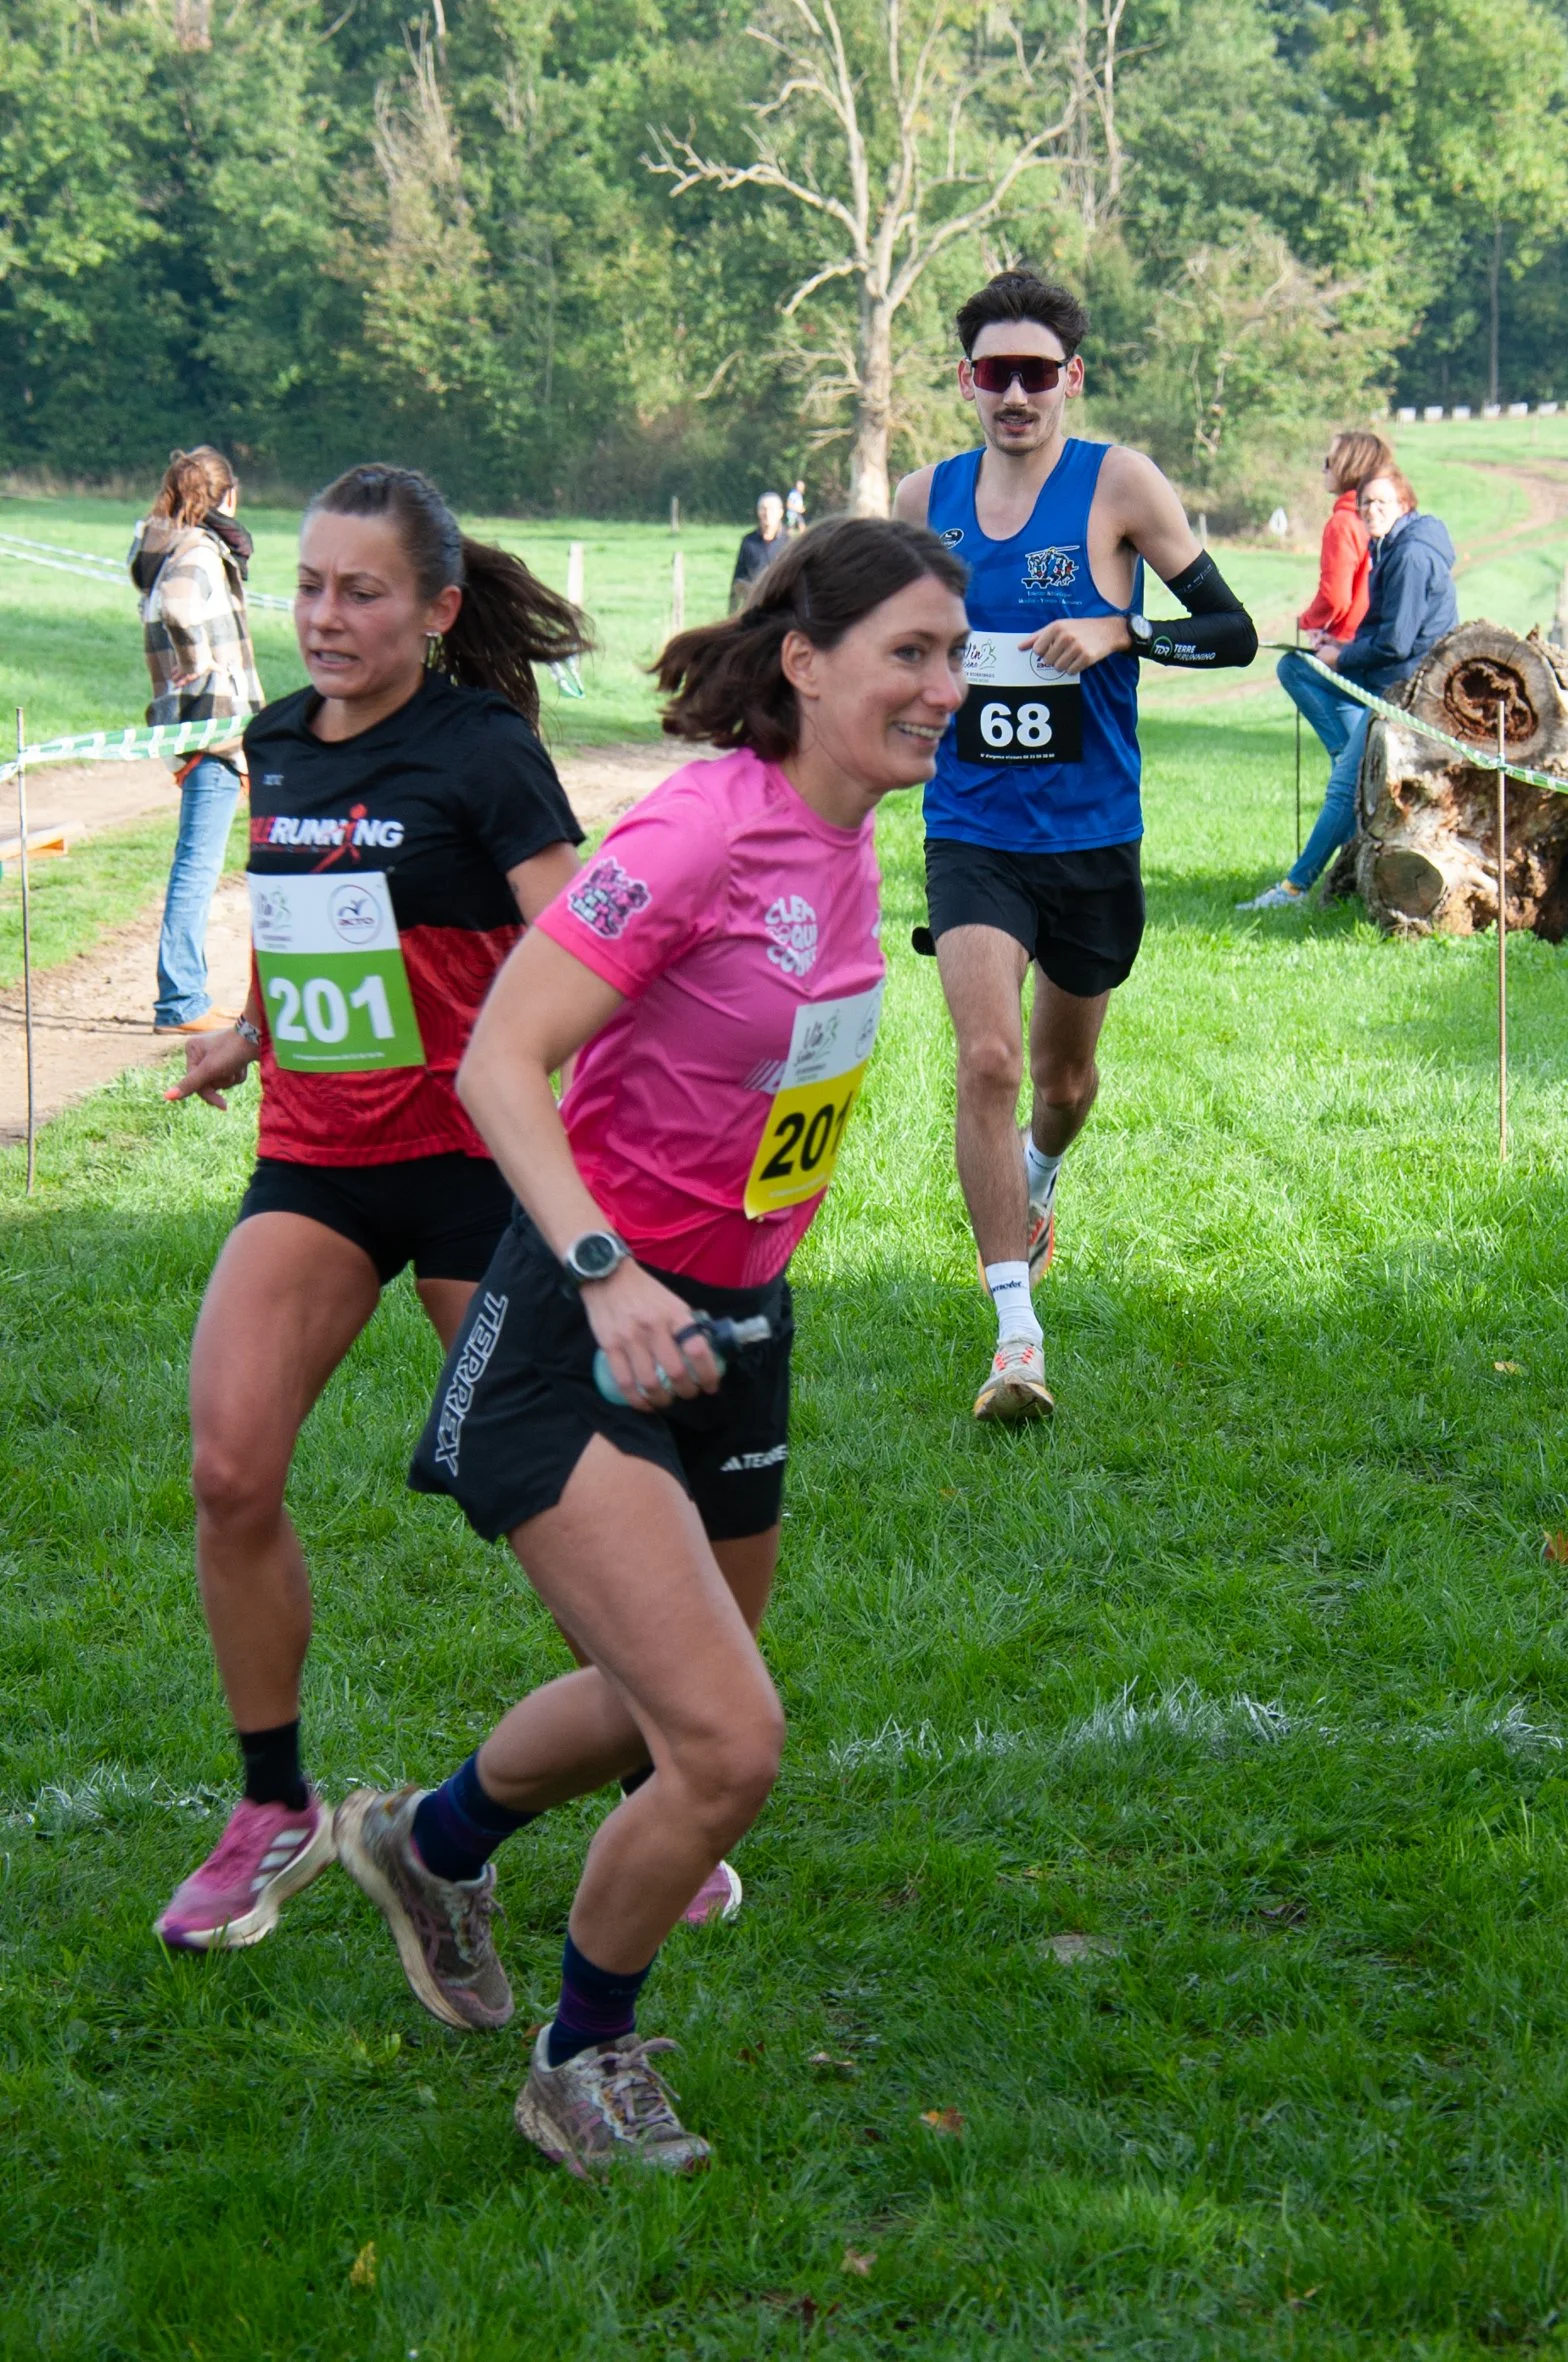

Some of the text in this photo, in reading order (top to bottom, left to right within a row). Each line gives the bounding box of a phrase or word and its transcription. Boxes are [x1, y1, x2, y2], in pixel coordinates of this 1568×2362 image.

[1154, 644, 1170, 656] TDR
[1174, 643, 1197, 654] TERRE
[980, 702, 1053, 748] 68
[268, 973, 396, 1044] 201
[434, 1291, 510, 1478] TERREX
